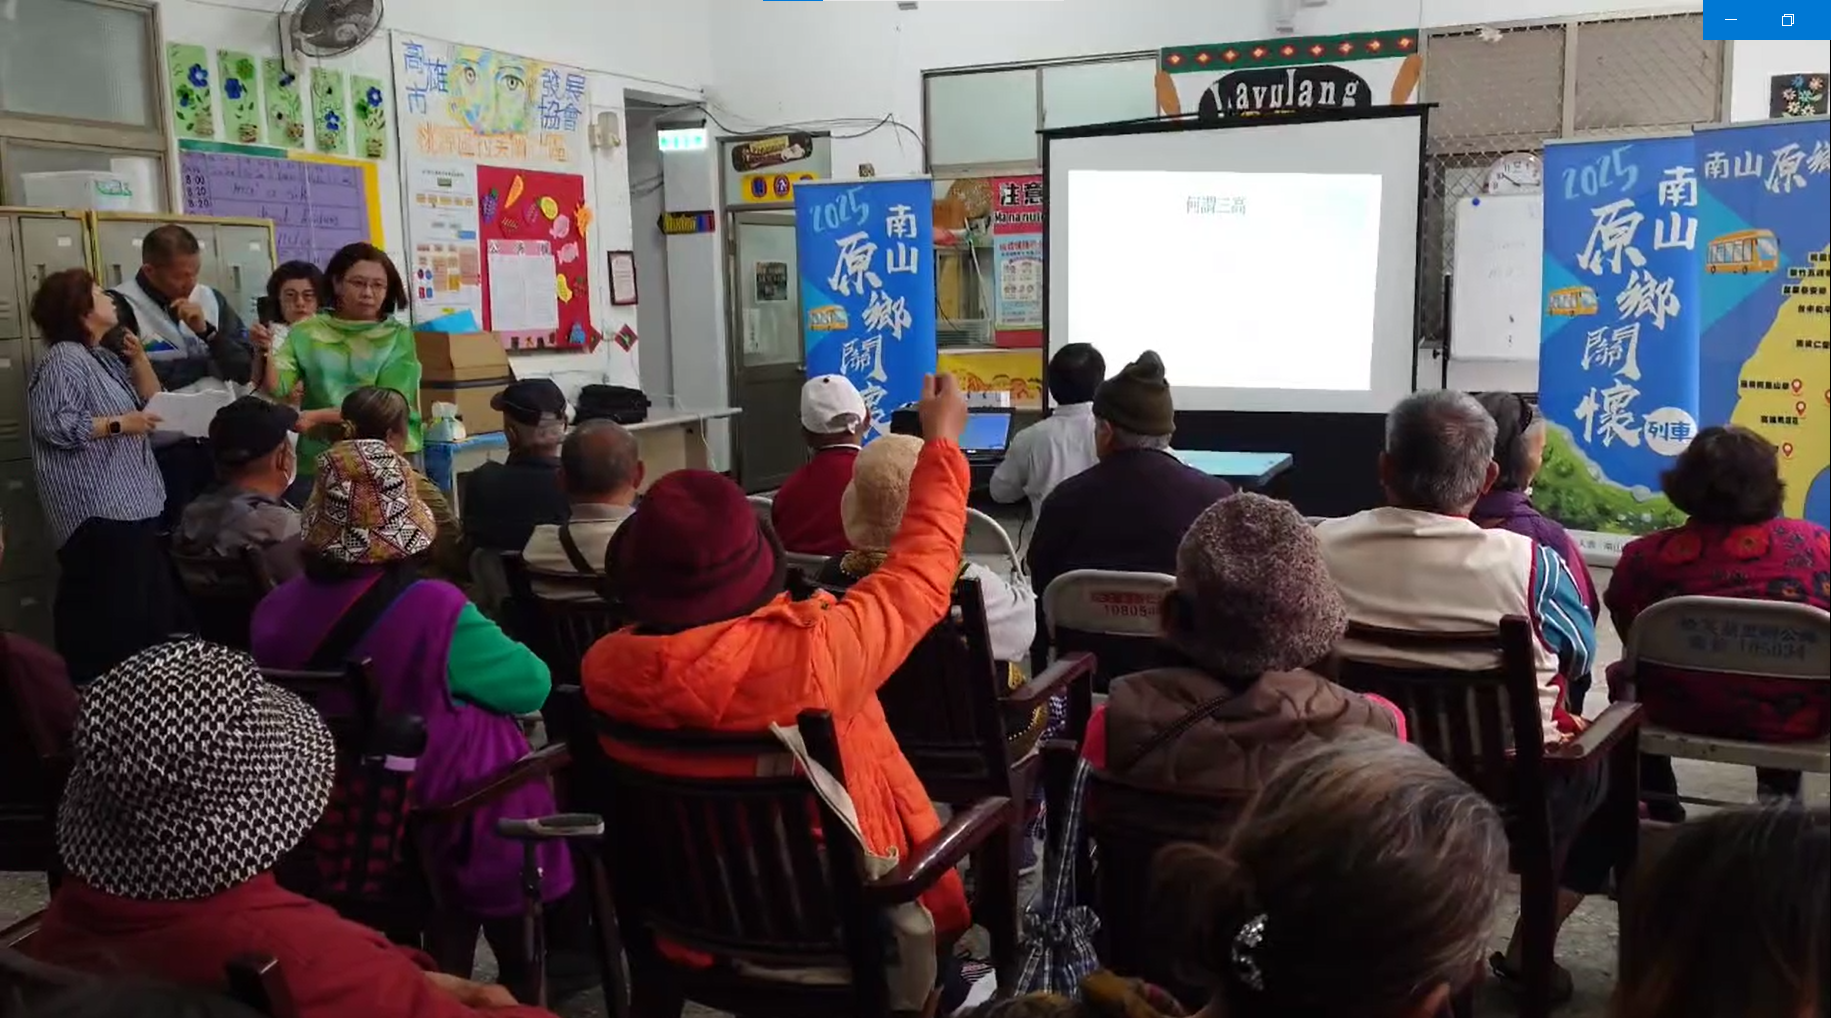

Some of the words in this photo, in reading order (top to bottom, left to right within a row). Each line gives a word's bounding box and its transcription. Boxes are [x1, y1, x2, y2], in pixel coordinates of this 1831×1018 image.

[1000, 181, 1042, 206] 注意
[1561, 144, 1639, 200] 2025
[810, 186, 870, 233] 2025
[1186, 195, 1246, 215] 何謂三高
[1653, 165, 1698, 251] 南山
[886, 204, 918, 274] 南山
[1648, 420, 1693, 443] 列車
